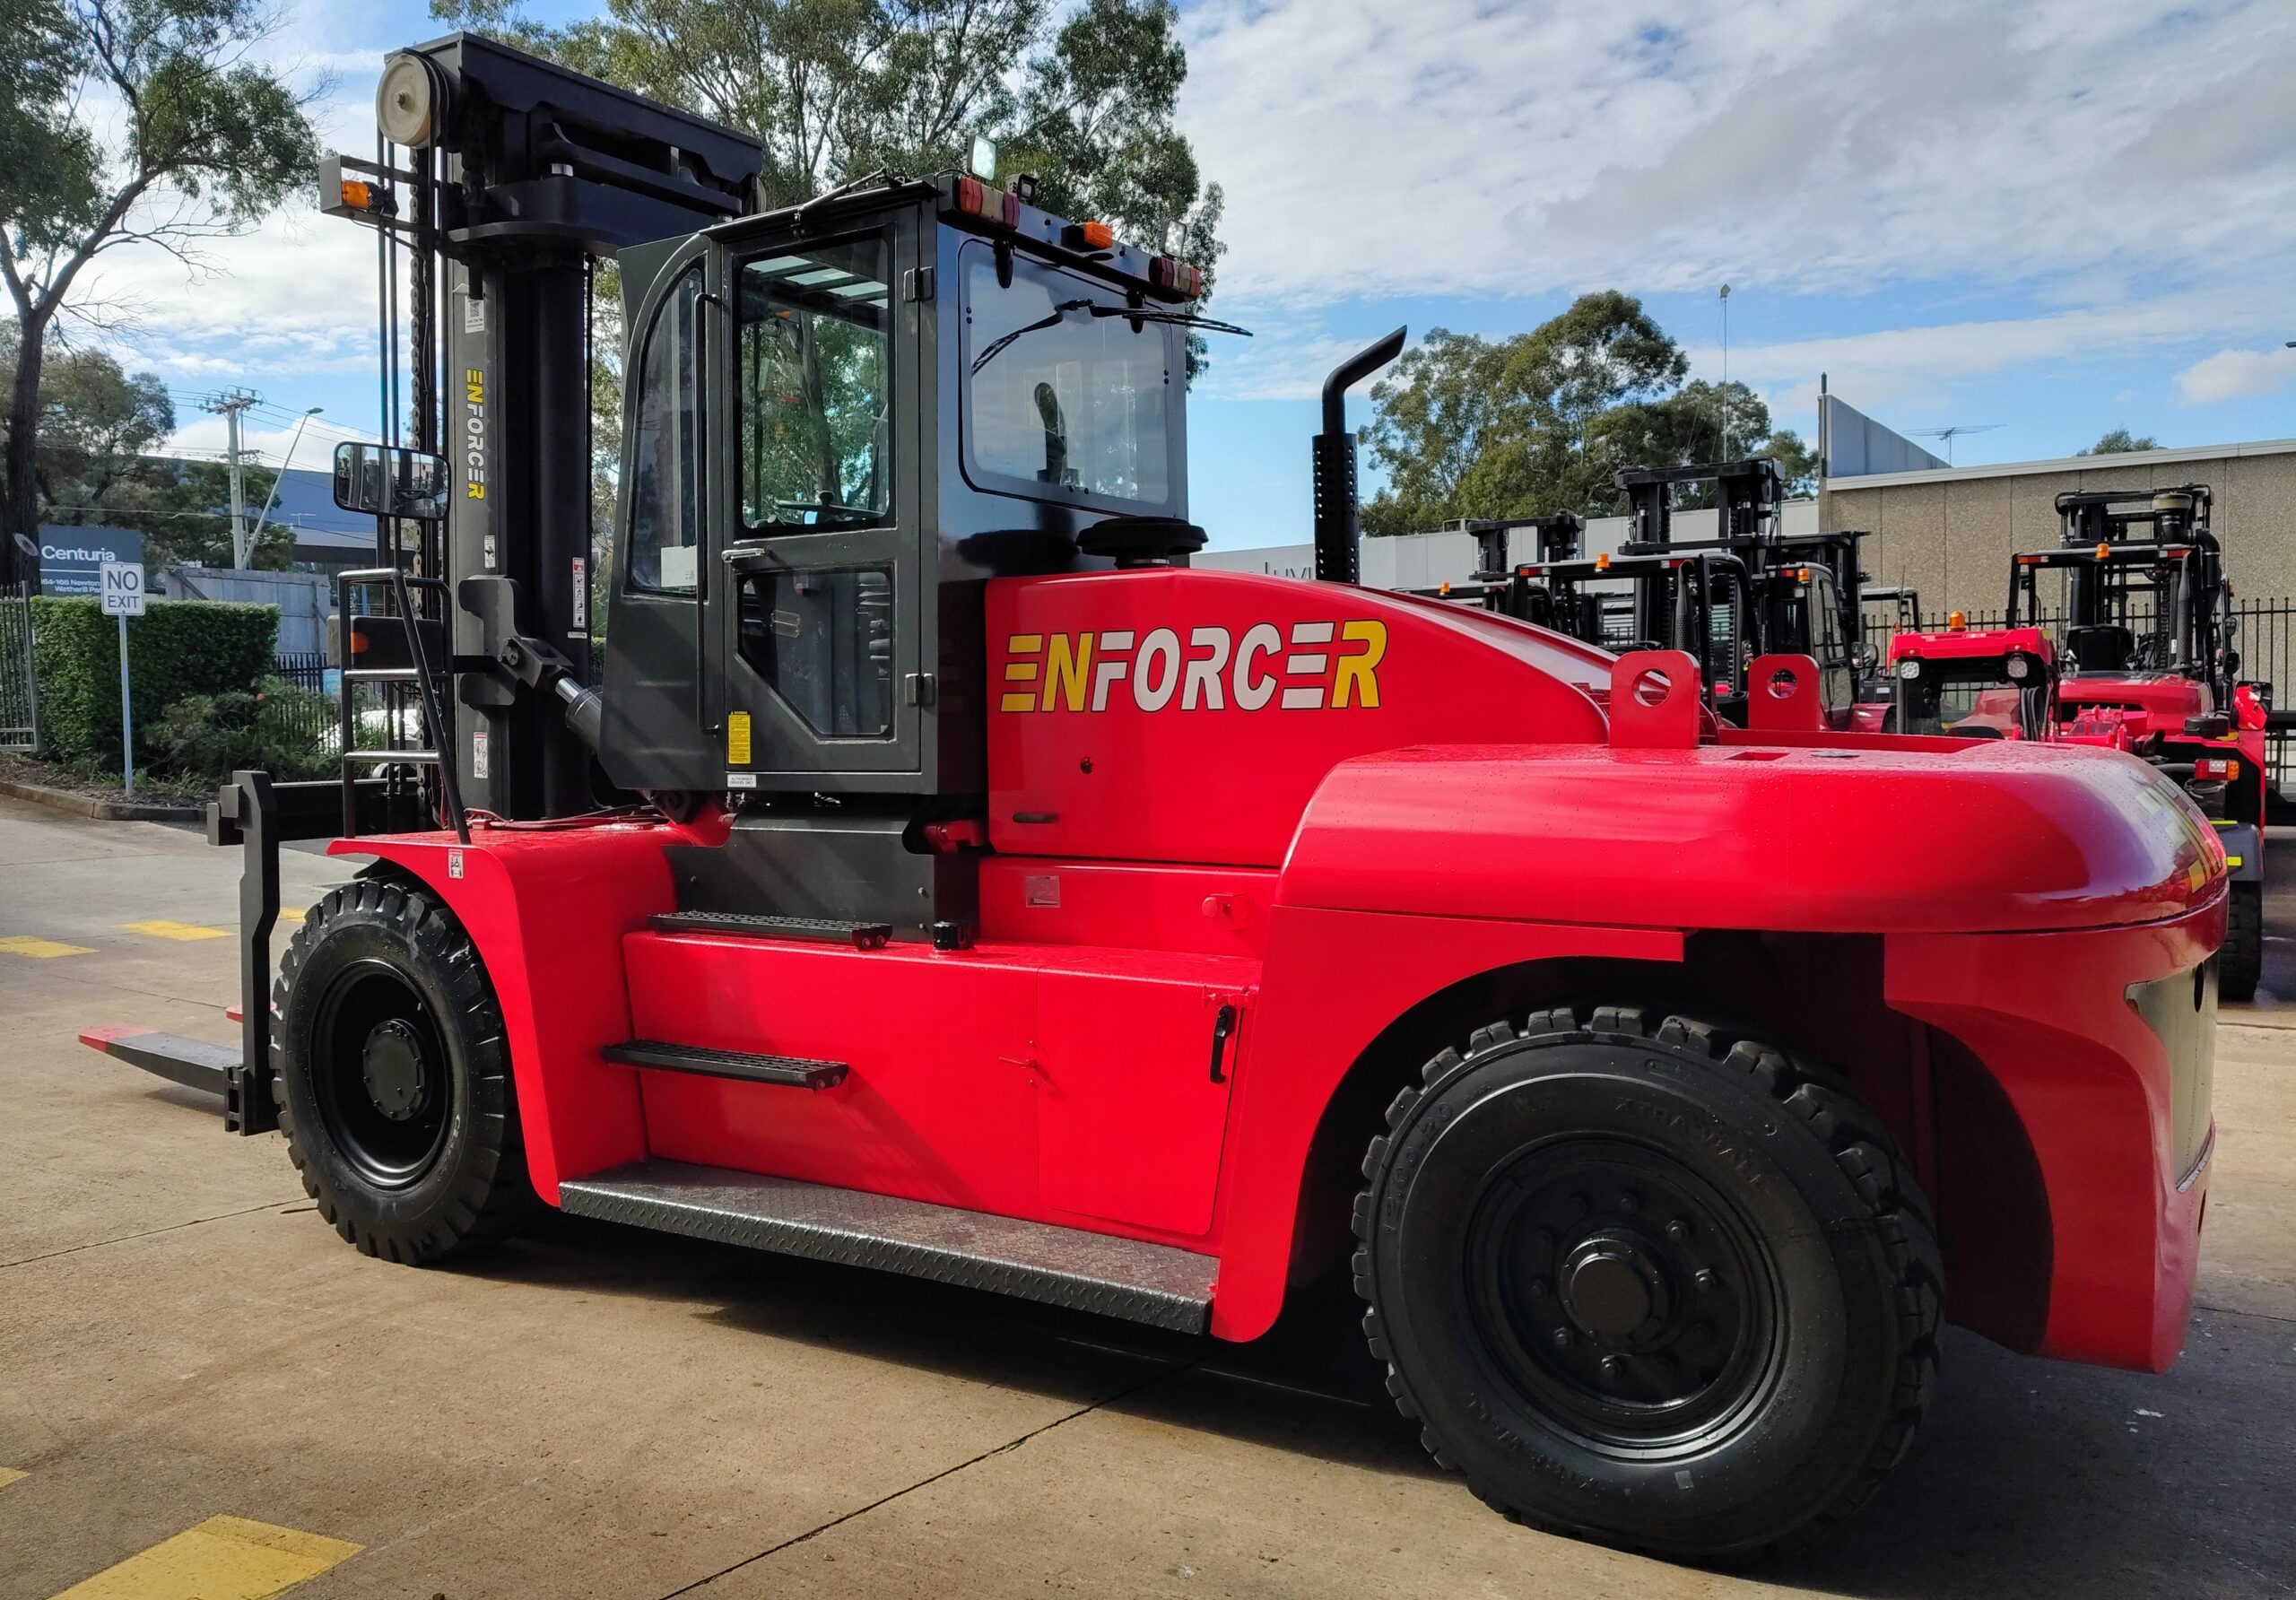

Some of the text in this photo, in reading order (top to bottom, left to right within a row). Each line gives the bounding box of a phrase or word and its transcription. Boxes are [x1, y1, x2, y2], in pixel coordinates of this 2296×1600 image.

[466, 370, 485, 500] ENFORCER
[41, 544, 116, 561] Centuria
[70, 578, 100, 587] Newton
[108, 570, 138, 591] NO
[55, 586, 88, 594] Wetherill
[108, 595, 140, 609] EXIT
[1000, 619, 1387, 712] ENFORCER
